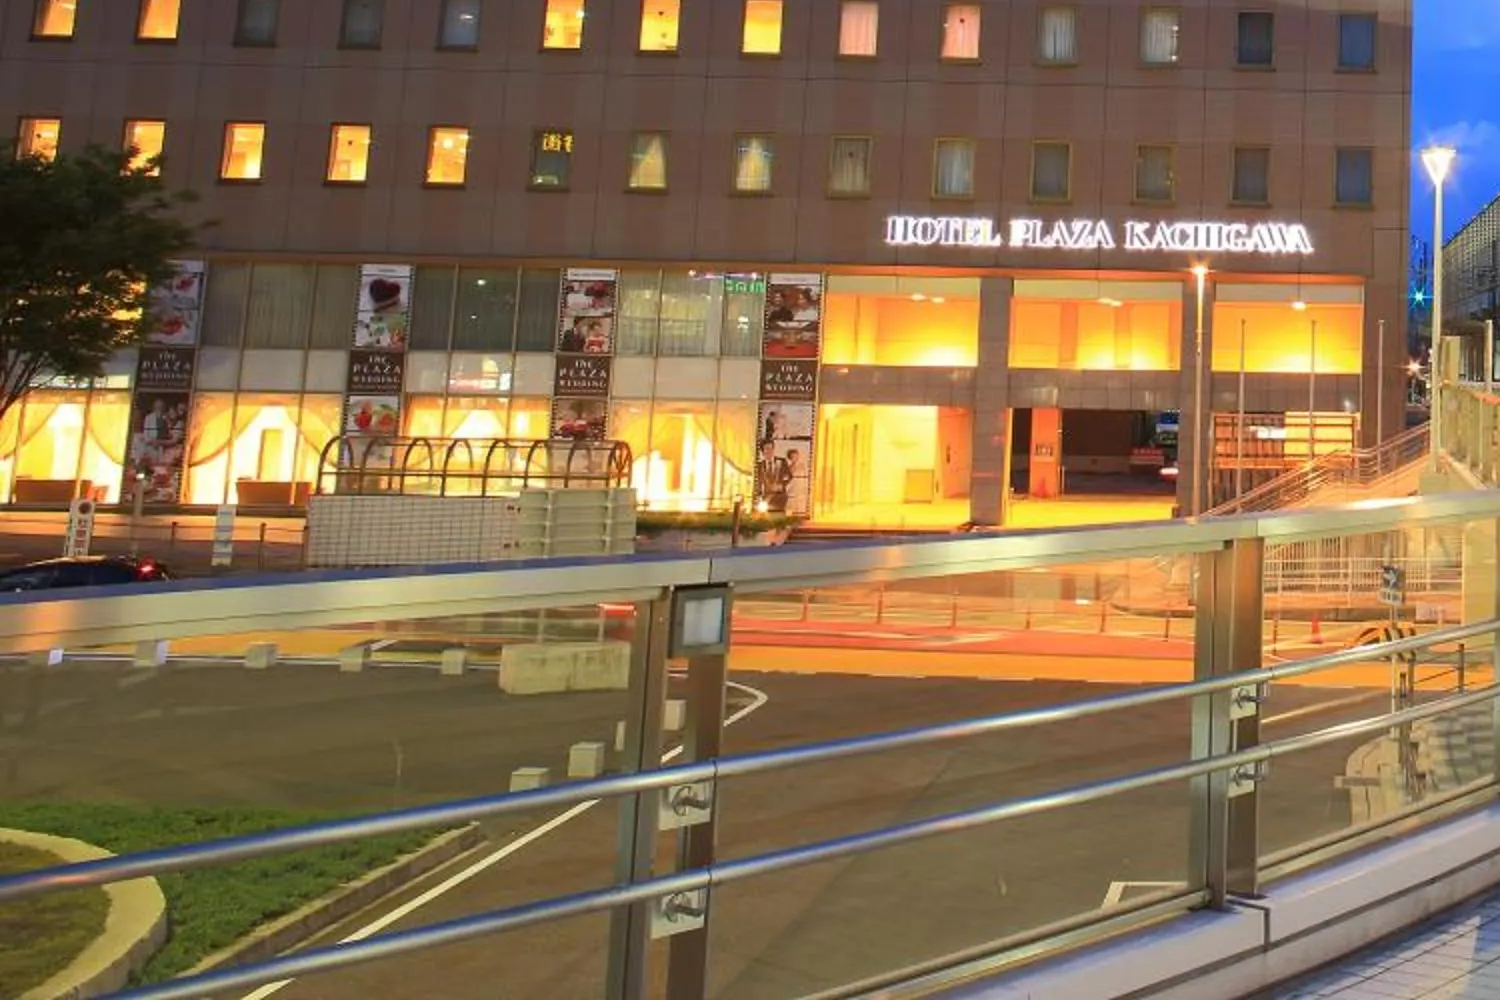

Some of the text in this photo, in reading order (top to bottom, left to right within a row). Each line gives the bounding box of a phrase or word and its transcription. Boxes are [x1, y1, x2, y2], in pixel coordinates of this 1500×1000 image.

[885, 216, 1314, 254] HOTEL PLAZA KACHIGAWA
[353, 364, 401, 374] PLAZA
[559, 367, 607, 378] PLAZA
[765, 372, 813, 383] PLAZA
